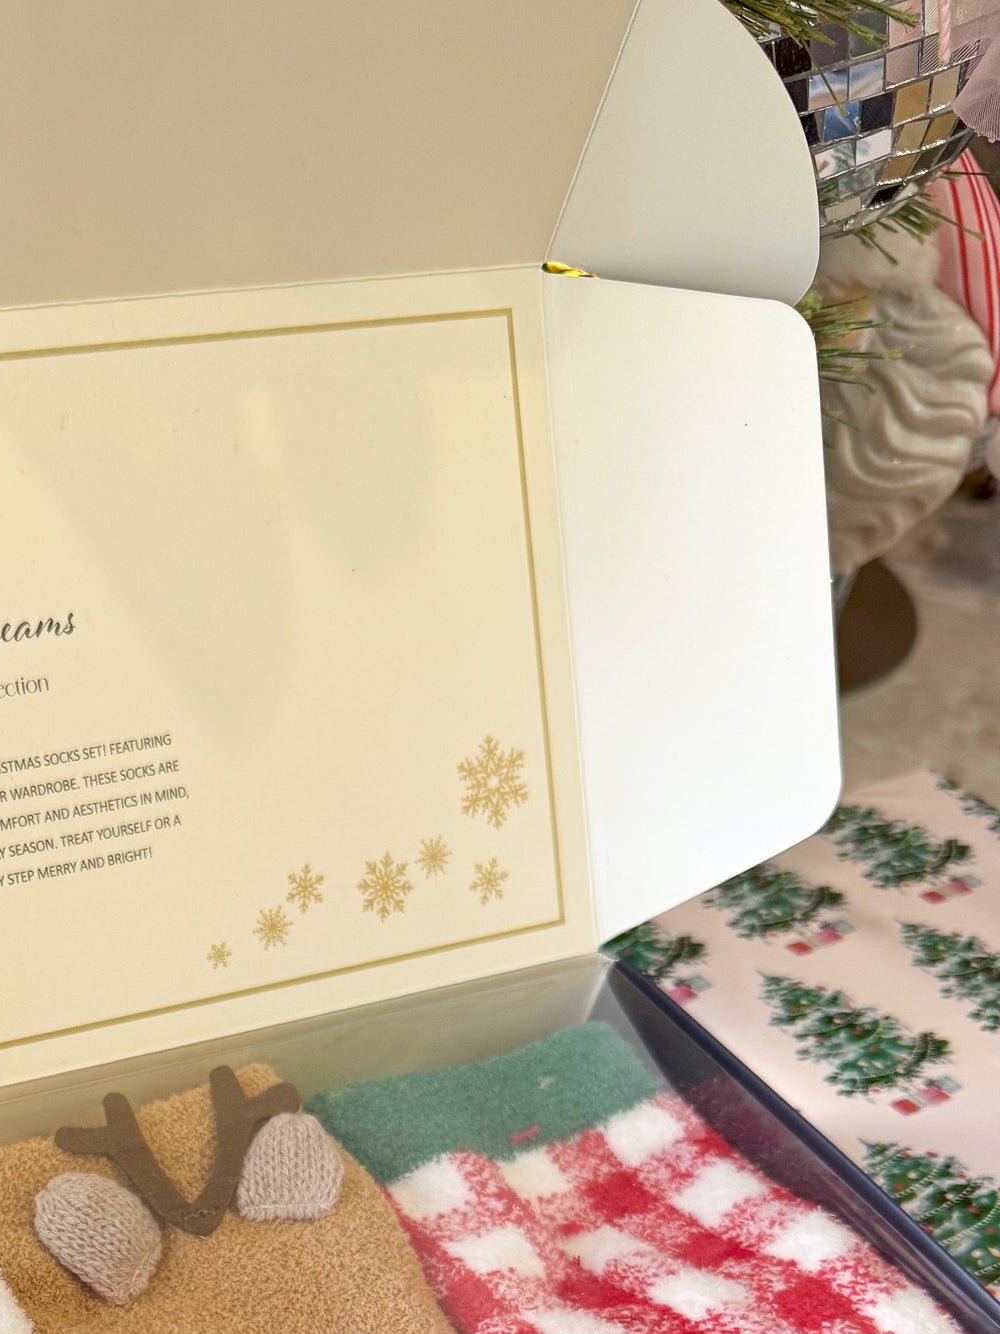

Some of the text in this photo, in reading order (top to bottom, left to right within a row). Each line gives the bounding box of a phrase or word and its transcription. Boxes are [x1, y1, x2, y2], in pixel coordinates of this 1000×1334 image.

[43, 749, 81, 767] SOCKS
[82, 743, 107, 761] SET!
[108, 733, 172, 756] FEATURING
[8, 777, 81, 801] WARDROBE.
[81, 770, 119, 789] THESE
[119, 763, 157, 782] SOCKS
[157, 759, 180, 775] ARE
[44, 807, 71, 824] AND
[72, 794, 139, 819] AESTHETICS
[139, 791, 153, 806] IN
[154, 786, 190, 803] MIND,
[8, 837, 59, 858] SEASON.
[58, 829, 95, 848] TREAT
[95, 819, 152, 841] YOURSELF
[153, 816, 171, 830] OR
[173, 814, 182, 827] A
[6, 869, 35, 886] STEP
[36, 861, 78, 880] MERRY
[79, 856, 106, 872] AND
[106, 846, 153, 867] BRIGHT!
